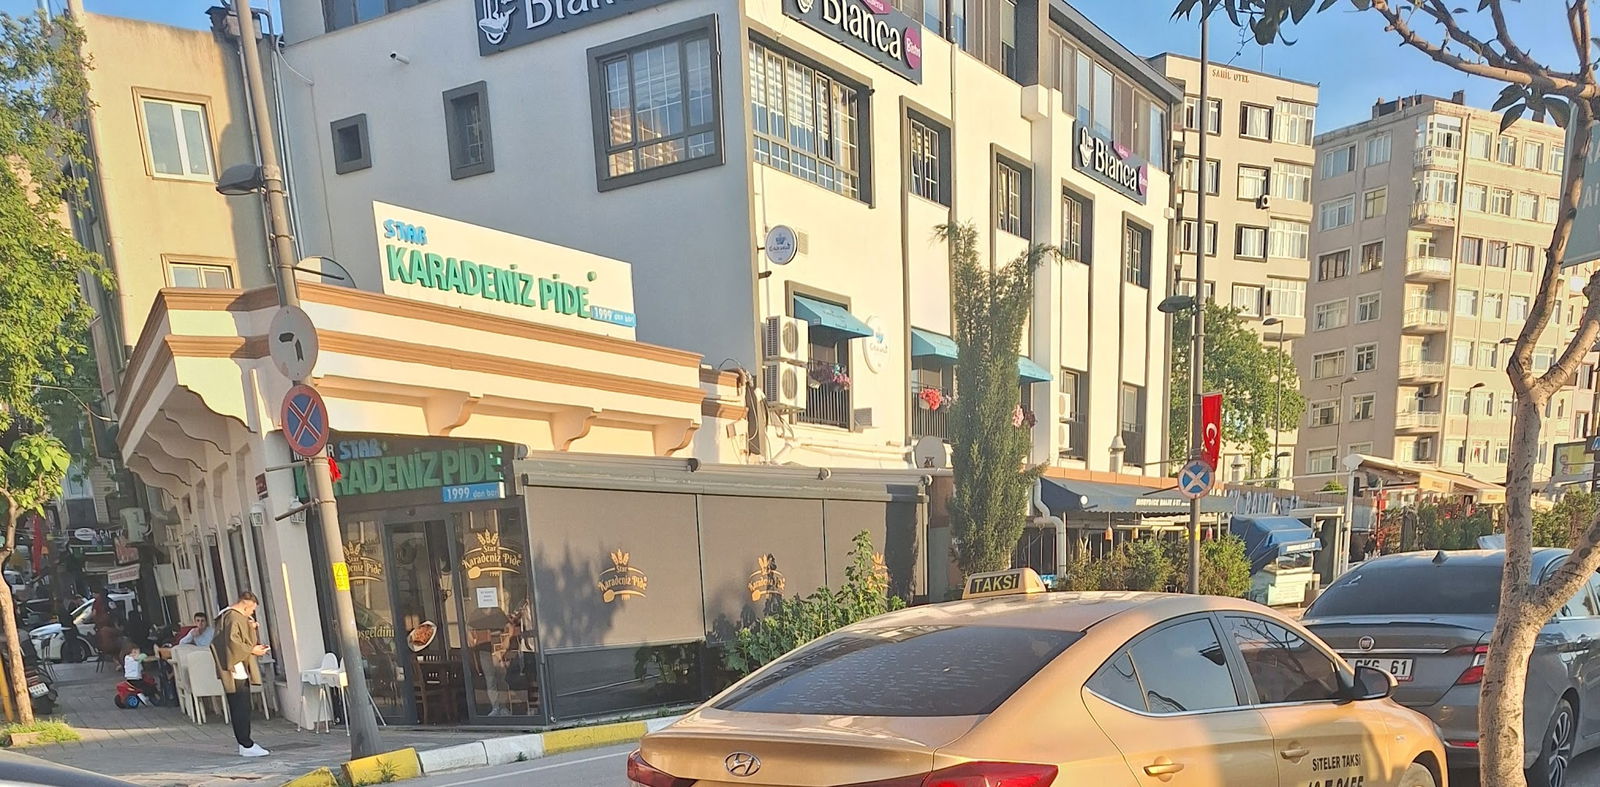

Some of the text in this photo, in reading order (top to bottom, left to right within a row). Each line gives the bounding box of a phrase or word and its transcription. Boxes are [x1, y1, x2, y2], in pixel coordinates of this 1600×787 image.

[1095, 137, 1137, 191] Bianca
[384, 219, 428, 245] STAR
[386, 244, 591, 319] KARADENİZ PİDE
[339, 438, 382, 461] STAR
[442, 442, 503, 486] PİDE
[447, 486, 470, 500] 1999
[462, 552, 522, 569] Karadeniz Pide
[482, 545, 497, 553] Star
[1390, 660, 1407, 675] 61
